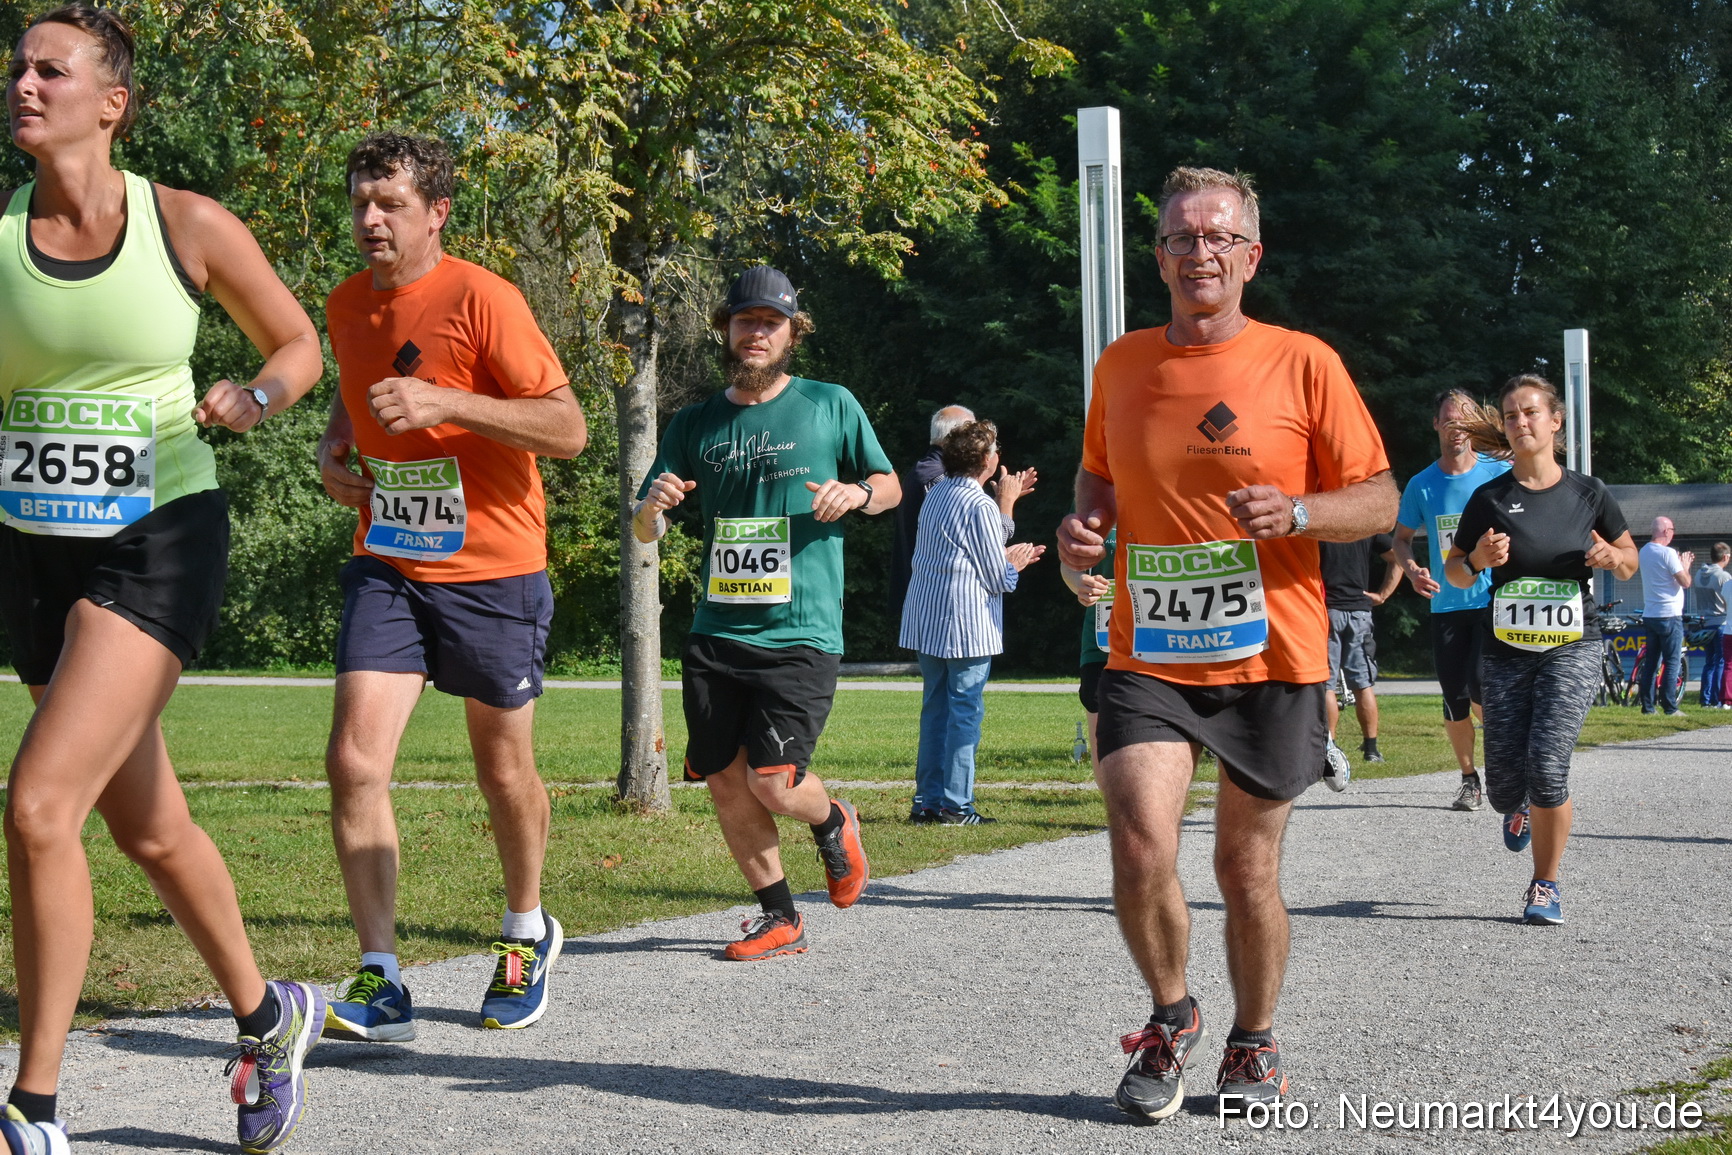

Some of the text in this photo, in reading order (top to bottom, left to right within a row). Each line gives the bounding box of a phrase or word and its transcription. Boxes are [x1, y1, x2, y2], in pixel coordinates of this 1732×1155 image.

[9, 397, 141, 432] BOCK
[1186, 445, 1252, 457] FliesenEichl
[11, 440, 136, 488] 2658
[367, 461, 451, 488] BOCK
[757, 466, 811, 485] AUTERHOFEN
[20, 498, 123, 521] BETTINA
[375, 492, 456, 527] 2474
[393, 532, 444, 549] FRANZ
[714, 548, 780, 574] 1046
[1136, 543, 1247, 577] BOCK
[718, 582, 773, 593] BASTIAN
[1501, 581, 1574, 598] BOCK
[1142, 581, 1248, 623] 2475
[1505, 603, 1574, 627] 1110
[1166, 631, 1234, 650] FRANZ
[1506, 632, 1570, 643] STEFANIE
